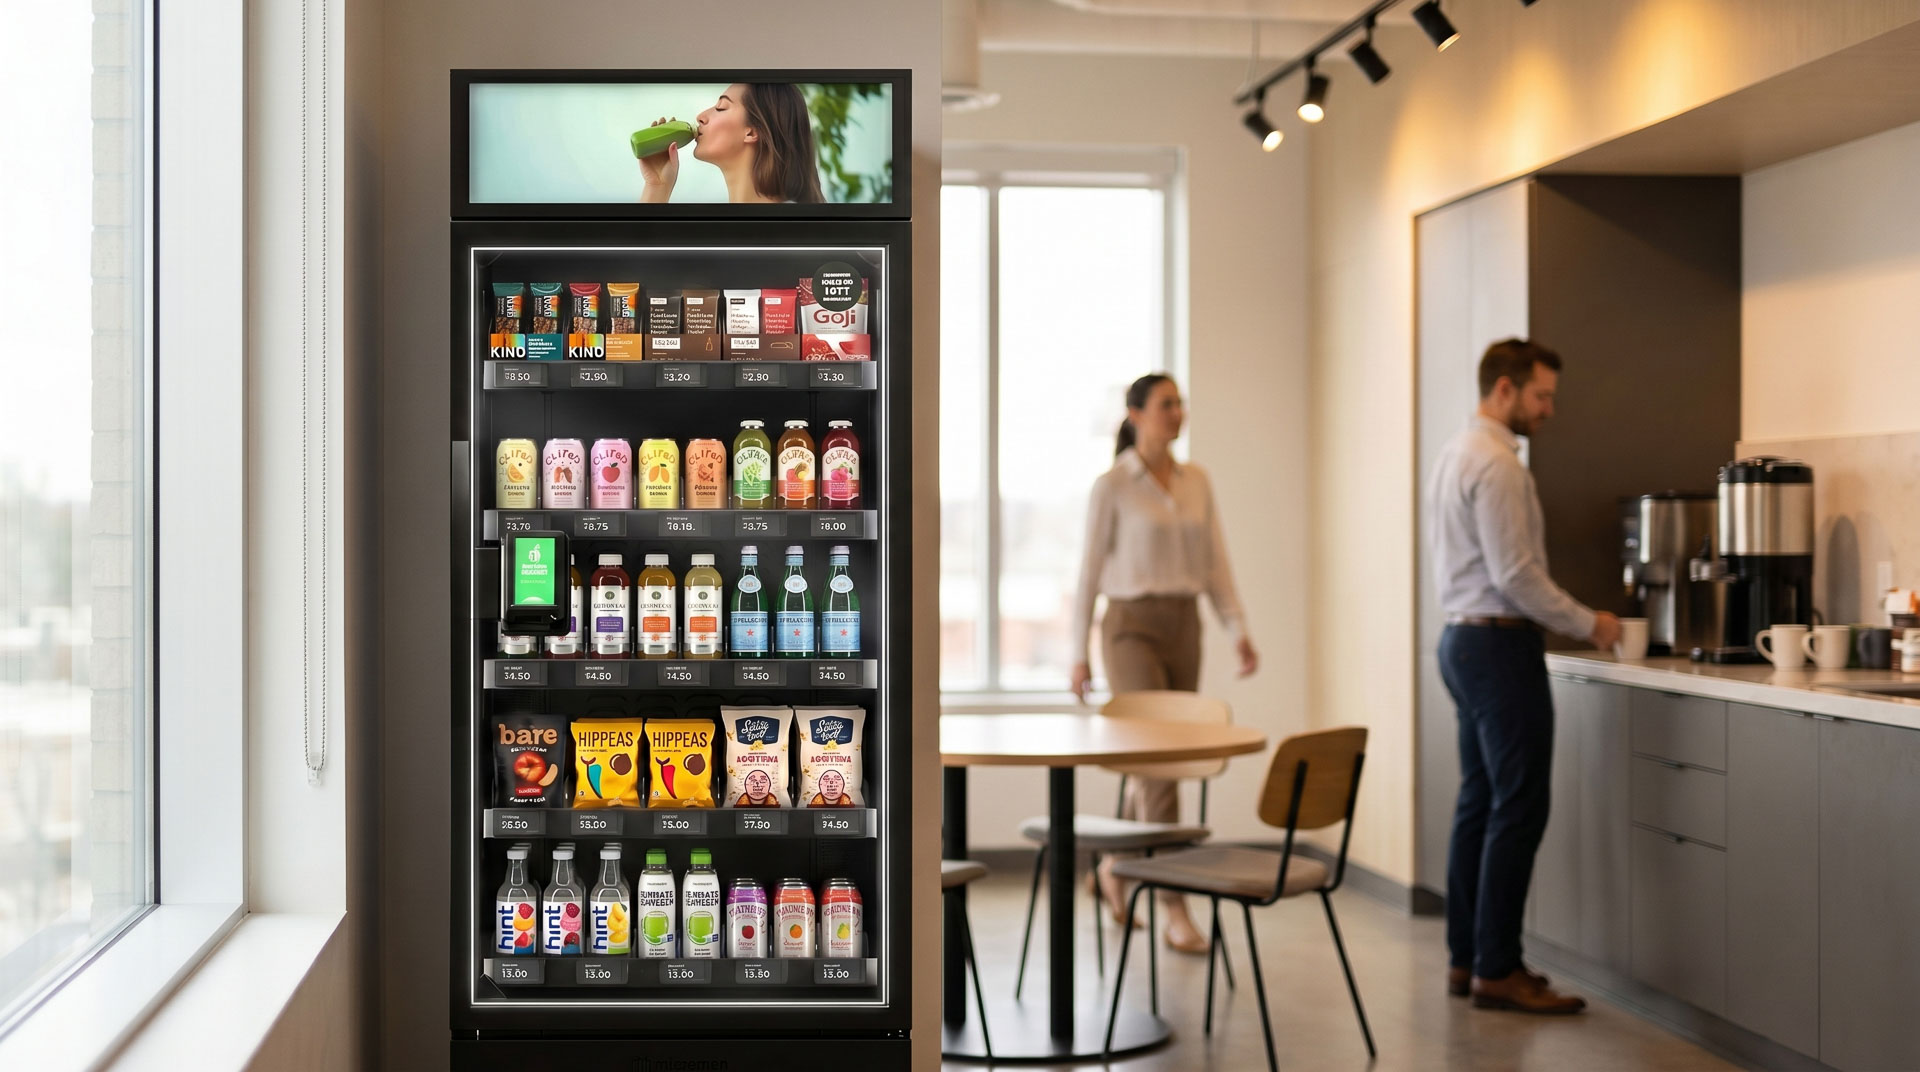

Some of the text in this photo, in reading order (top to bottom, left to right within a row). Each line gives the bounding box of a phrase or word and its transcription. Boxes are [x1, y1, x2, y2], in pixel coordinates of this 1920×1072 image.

[491, 346, 526, 358] KIND
[569, 346, 604, 358] KIND
[498, 724, 557, 745] bare
[579, 731, 633, 747] HIPPEAS
[653, 731, 707, 748] HIPPEAS
[498, 905, 514, 950] hint
[545, 905, 561, 950] hint
[592, 905, 608, 950] hint
